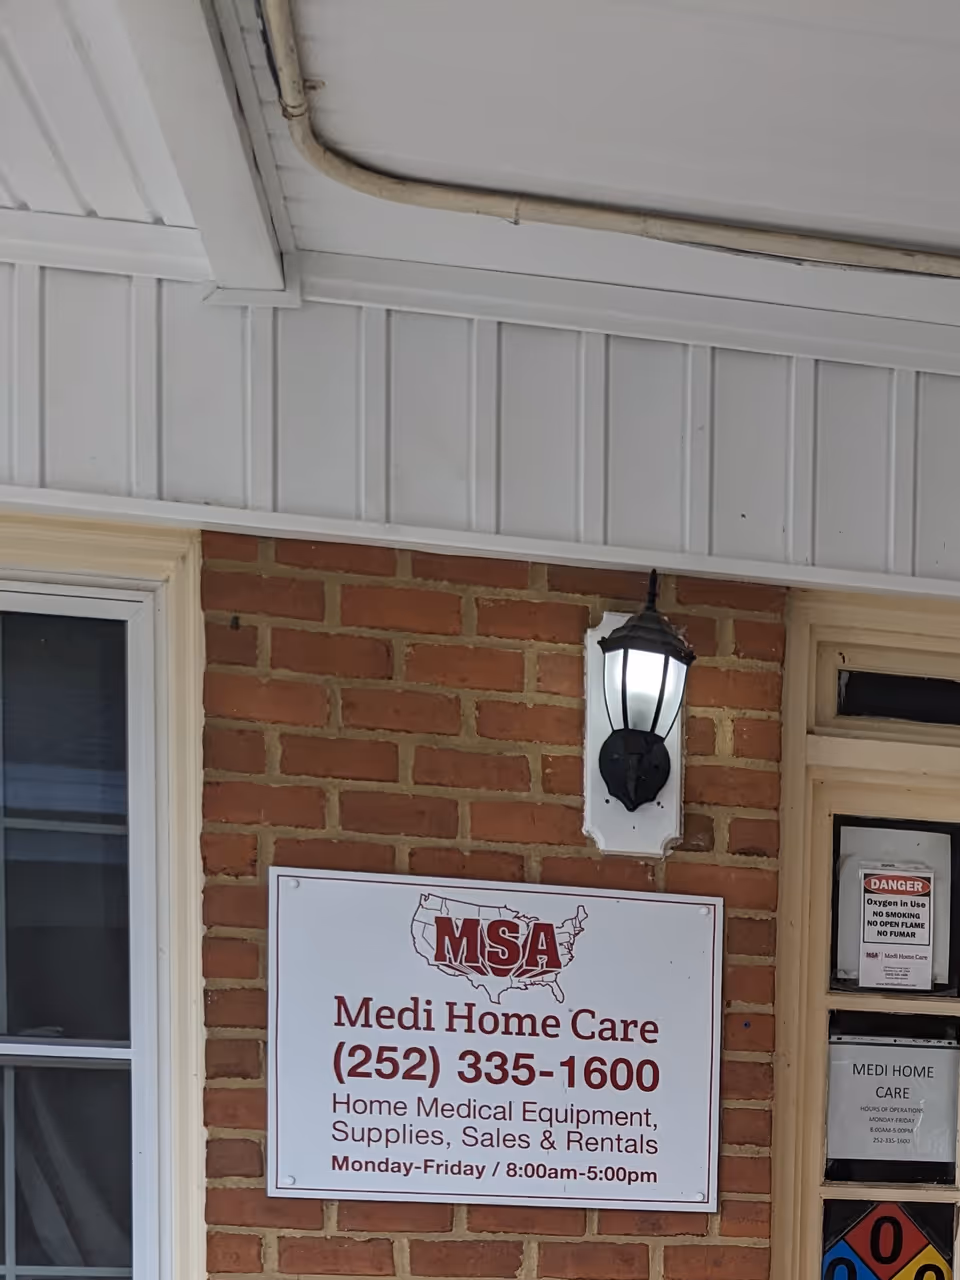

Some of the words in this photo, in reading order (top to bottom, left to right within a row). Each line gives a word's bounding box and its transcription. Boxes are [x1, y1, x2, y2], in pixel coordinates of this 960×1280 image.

[870, 878, 923, 892] DANGER
[866, 898, 898, 907] Oxygen
[900, 899, 908, 907] in
[910, 900, 926, 908] Use
[885, 911, 920, 919] SMOKING
[879, 920, 900, 928] OPEN
[901, 922, 925, 930] FLAME
[434, 917, 563, 973] MSA
[333, 995, 436, 1032] Medi
[445, 1001, 561, 1038] Home
[570, 1008, 660, 1043] Care
[333, 1041, 440, 1088] (252)
[457, 1049, 660, 1093] 335-1600
[852, 1063, 888, 1076] MEDI
[892, 1065, 934, 1078] HOME
[875, 1086, 910, 1099] CARE
[332, 1093, 408, 1117] Home
[416, 1096, 513, 1122] Medical
[522, 1101, 659, 1130] Equipment,
[332, 1121, 452, 1149] Supplies,
[461, 1126, 531, 1149] Sales
[540, 1130, 557, 1151] &
[566, 1131, 659, 1154] Rentals
[332, 1155, 487, 1180] Monday-Friday
[492, 1160, 501, 1177] /
[505, 1162, 658, 1185] 8:00am-5:00pm
[870, 1216, 903, 1265] 0
